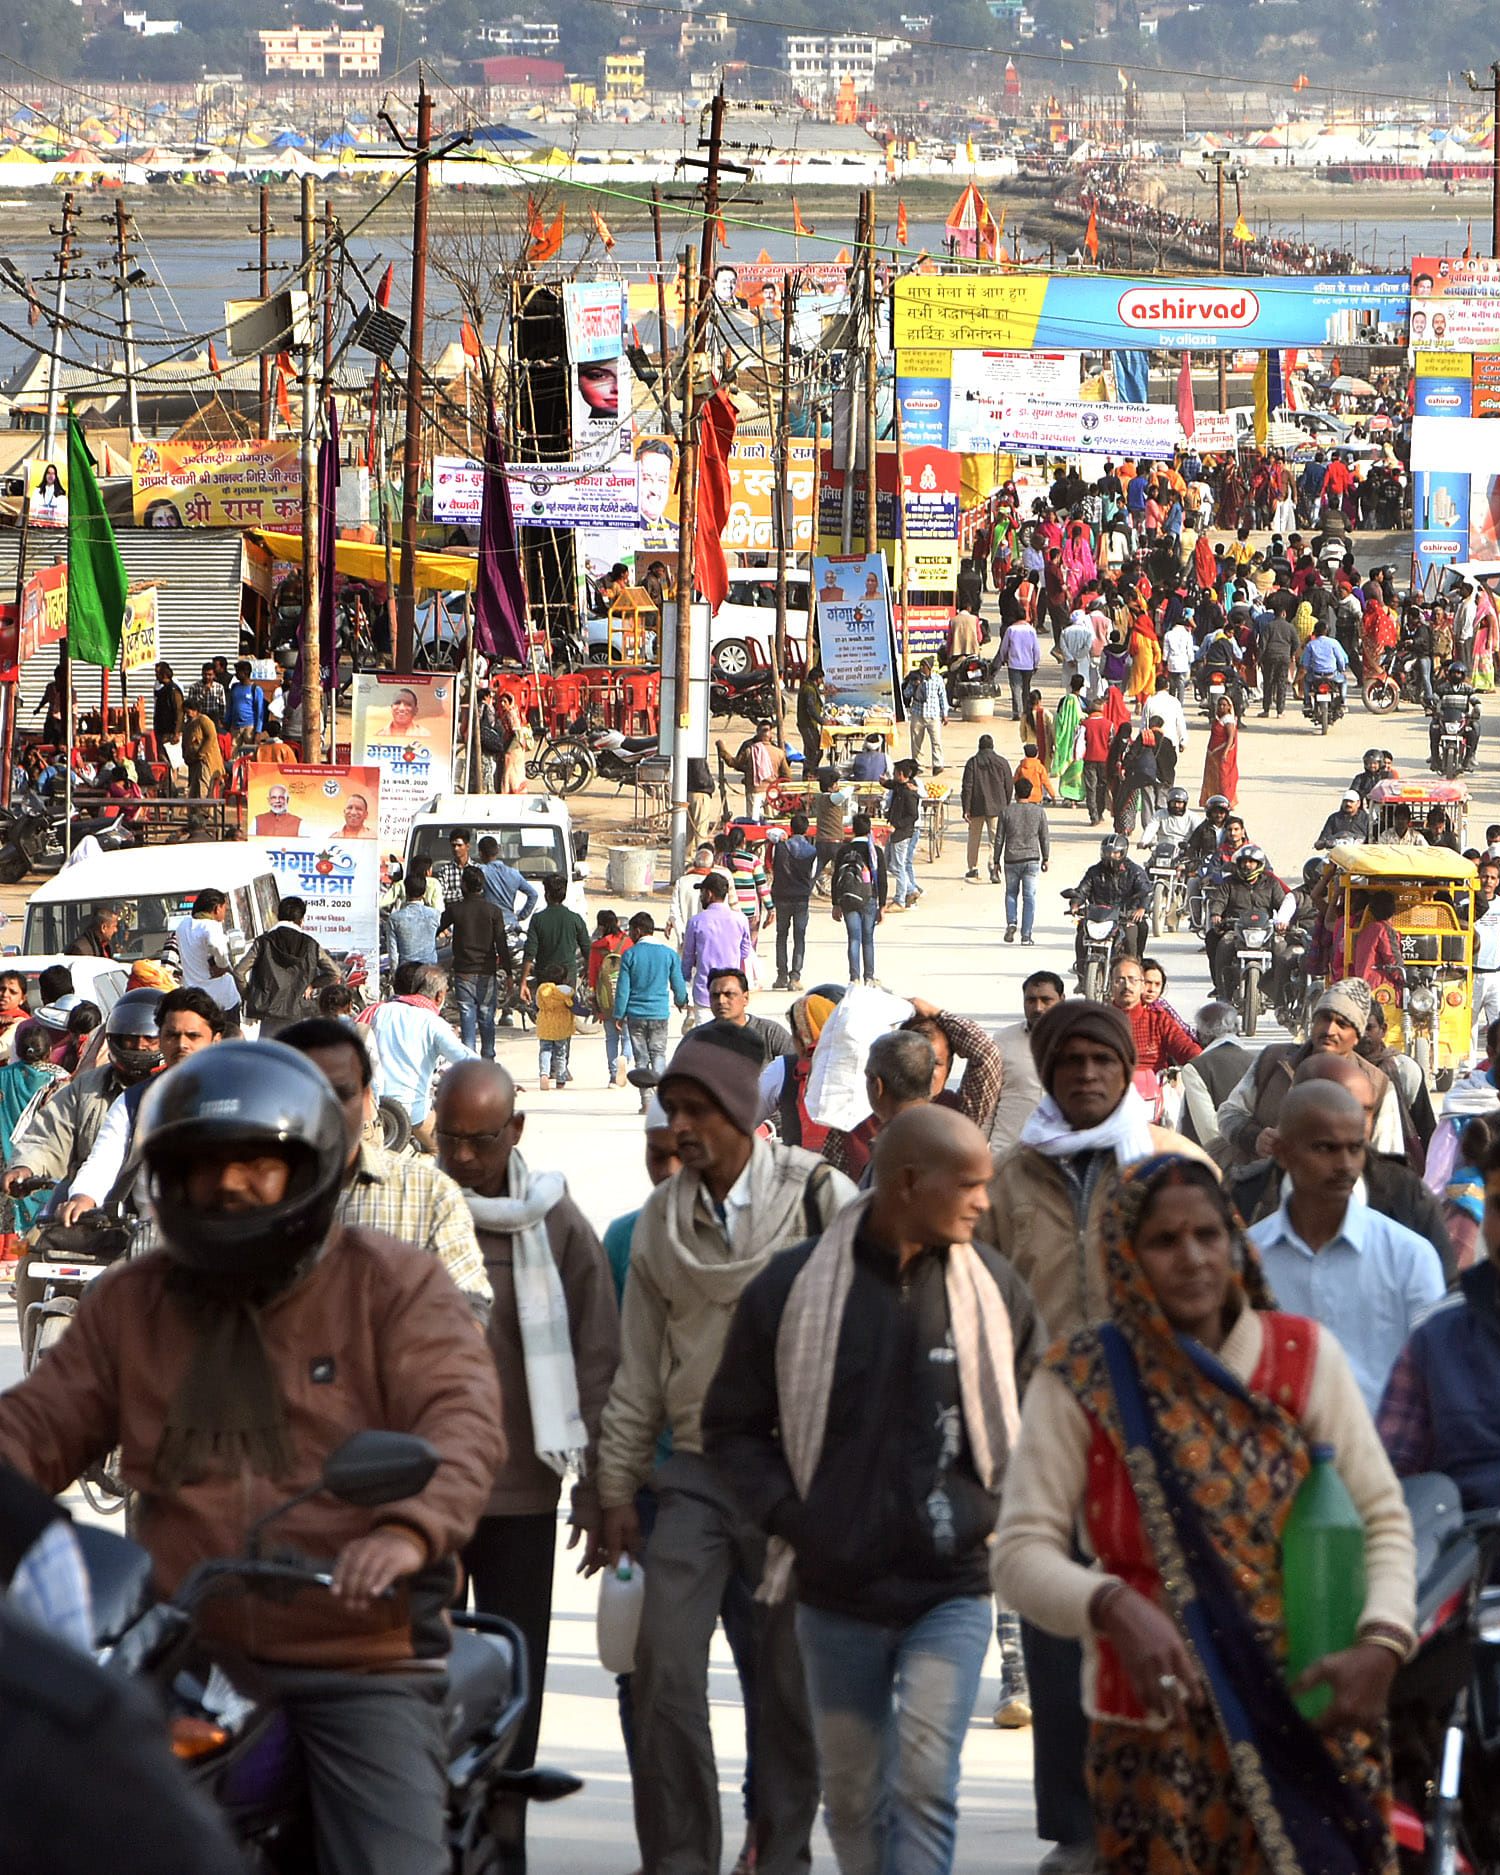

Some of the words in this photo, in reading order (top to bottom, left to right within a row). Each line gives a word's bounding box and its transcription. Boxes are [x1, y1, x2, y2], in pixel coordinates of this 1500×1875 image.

[907, 287, 931, 298] माघ
[936, 283, 962, 298] मेला
[966, 284, 977, 298] में
[981, 287, 1004, 302] आए
[1008, 287, 1028, 302] हुए
[907, 304, 932, 319] सभी
[993, 308, 1009, 320] का
[1131, 298, 1246, 319] ashirvad
[907, 325, 945, 341] हार्दिक
[1159, 334, 1175, 346] by
[1176, 333, 1217, 345] aliaxis
[1428, 397, 1459, 405] ashirvad
[138, 471, 168, 488] आचार्य
[171, 470, 197, 485] स्वामी
[199, 470, 211, 485] श्री
[213, 472, 244, 485] आनन्द
[246, 468, 266, 484] गिरि
[268, 468, 281, 484] जी
[282, 471, 302, 485] महा
[455, 473, 468, 483] डा.
[606, 473, 636, 487] खेतान
[184, 491, 212, 523] श्री
[220, 498, 265, 522] राम
[449, 498, 480, 511] वैष्णवी
[826, 606, 853, 621] गंगा
[845, 620, 875, 633] यात्रा
[367, 743, 402, 761] गंगा
[390, 761, 431, 776] यात्रा
[266, 847, 315, 874] गंगा
[298, 874, 355, 894] यात्रा
[303, 899, 329, 909] नवरी,
[331, 900, 352, 908] 2020
[306, 913, 314, 922] 21
